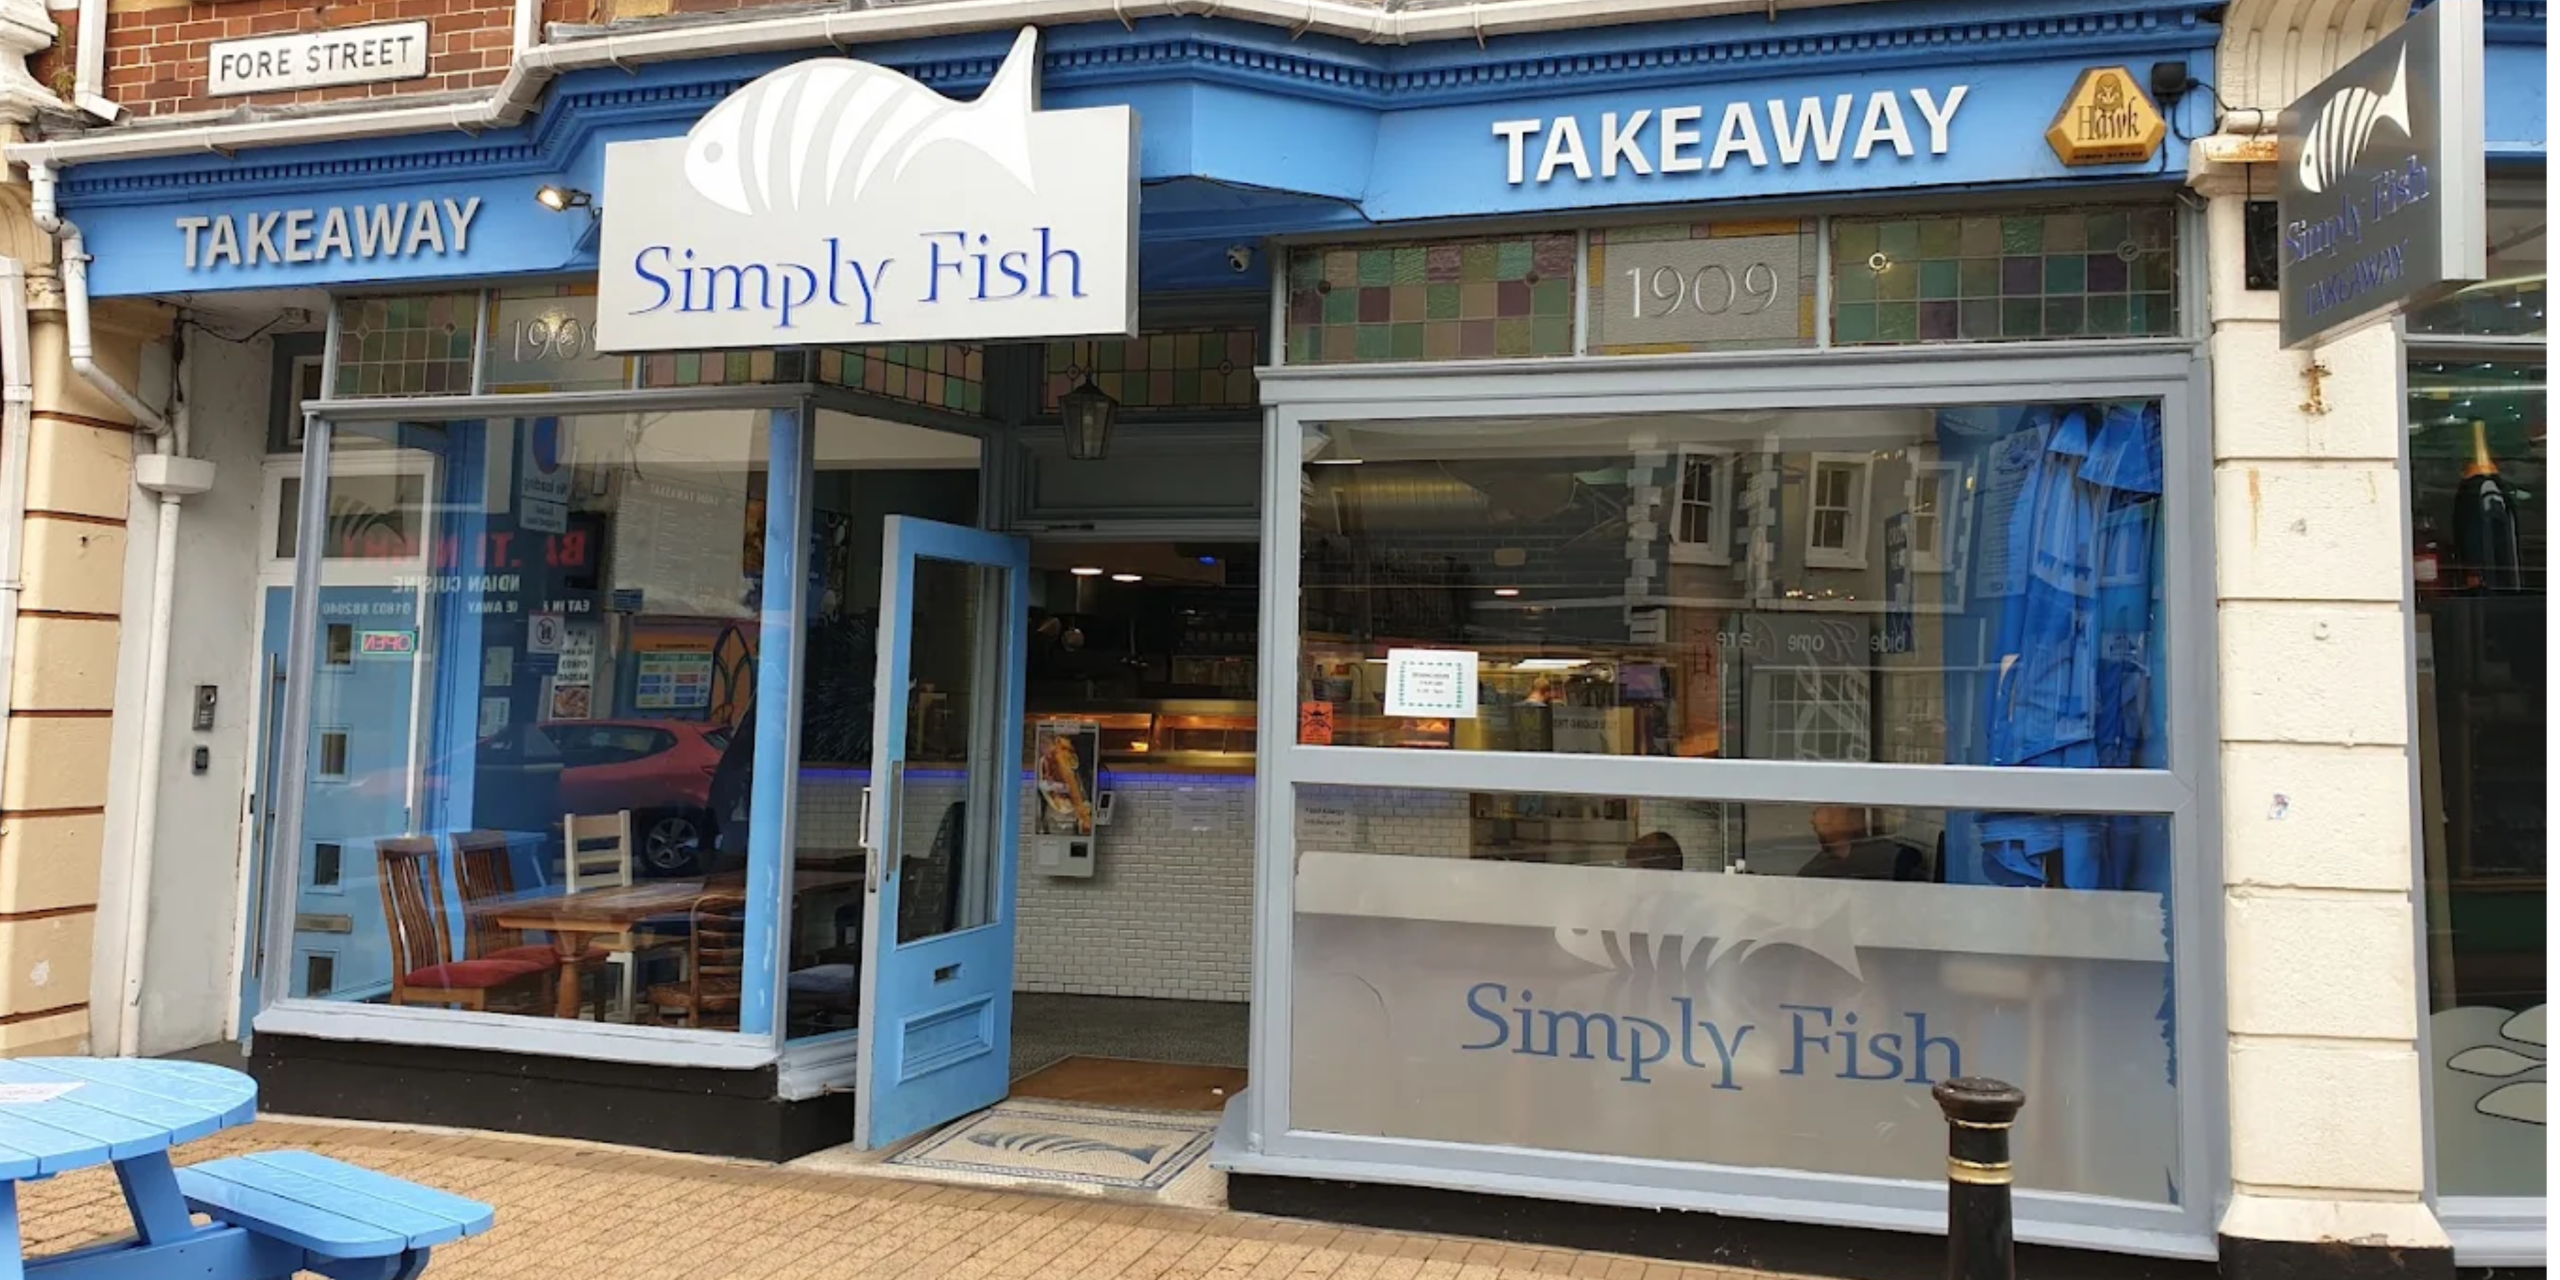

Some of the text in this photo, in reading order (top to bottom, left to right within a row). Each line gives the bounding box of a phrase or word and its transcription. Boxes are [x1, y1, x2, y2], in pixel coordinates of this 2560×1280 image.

[219, 35, 415, 83] FORE STREET
[1492, 85, 1969, 185] TAKEAWAY
[2076, 96, 2141, 141] Hawk
[176, 197, 482, 269] TAKEAWAY
[2284, 153, 2431, 268] Simply Fish
[627, 226, 1088, 329] Simply Fish
[1625, 261, 1780, 320] 1909
[2304, 237, 2409, 318] TAKEAWAY
[1460, 982, 1963, 1091] Simply Fish
